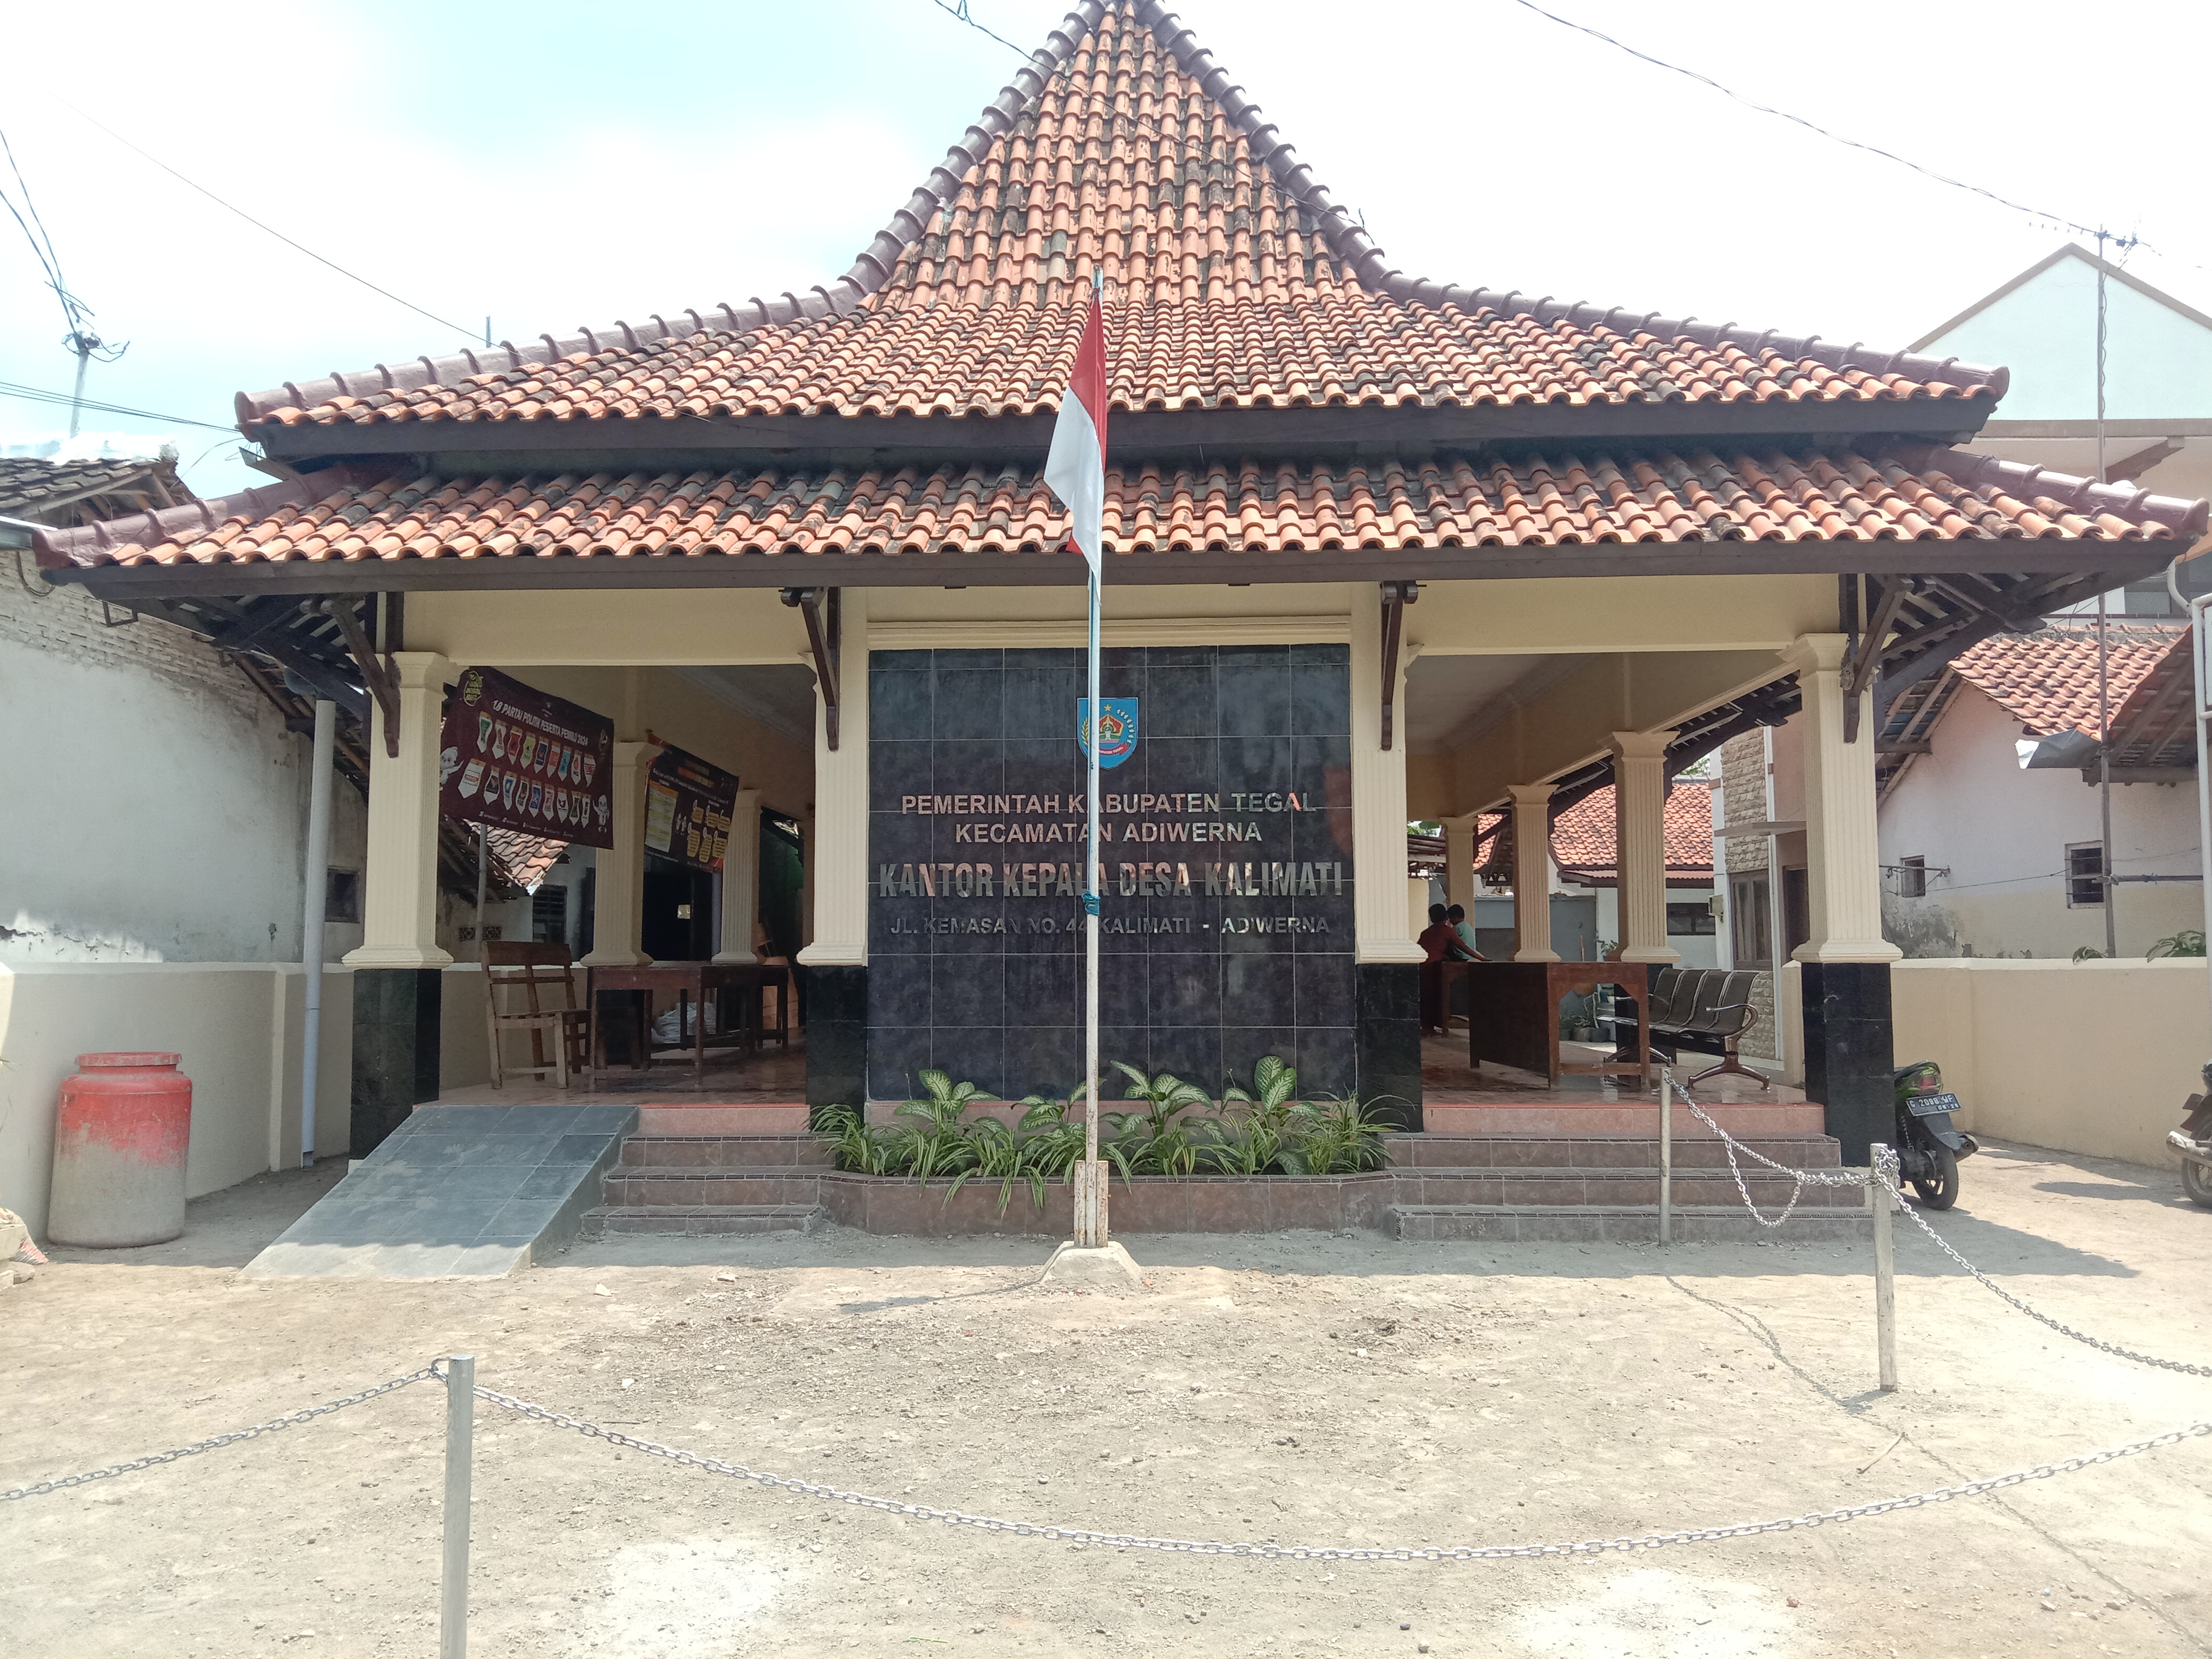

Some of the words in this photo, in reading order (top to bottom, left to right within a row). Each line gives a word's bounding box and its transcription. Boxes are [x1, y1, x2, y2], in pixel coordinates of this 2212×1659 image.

[493, 699, 504, 711] 18
[502, 703, 523, 722] PARTAI
[540, 719, 561, 736] PESERTA
[901, 794, 1059, 815] PEMERINTAH
[1231, 792, 1316, 812] TEGAL
[1122, 822, 1262, 842] ADIWERNA
[879, 862, 994, 897] KANTOR
[1119, 862, 1192, 896] DESA
[1204, 861, 1342, 896] KALIMATI
[891, 918, 918, 934] JL.
[924, 918, 1021, 934] KEMASAN
[1027, 918, 1060, 934] NO.
[1099, 917, 1190, 934] KALIMATI
[1221, 917, 1330, 934] ADIWERNA
